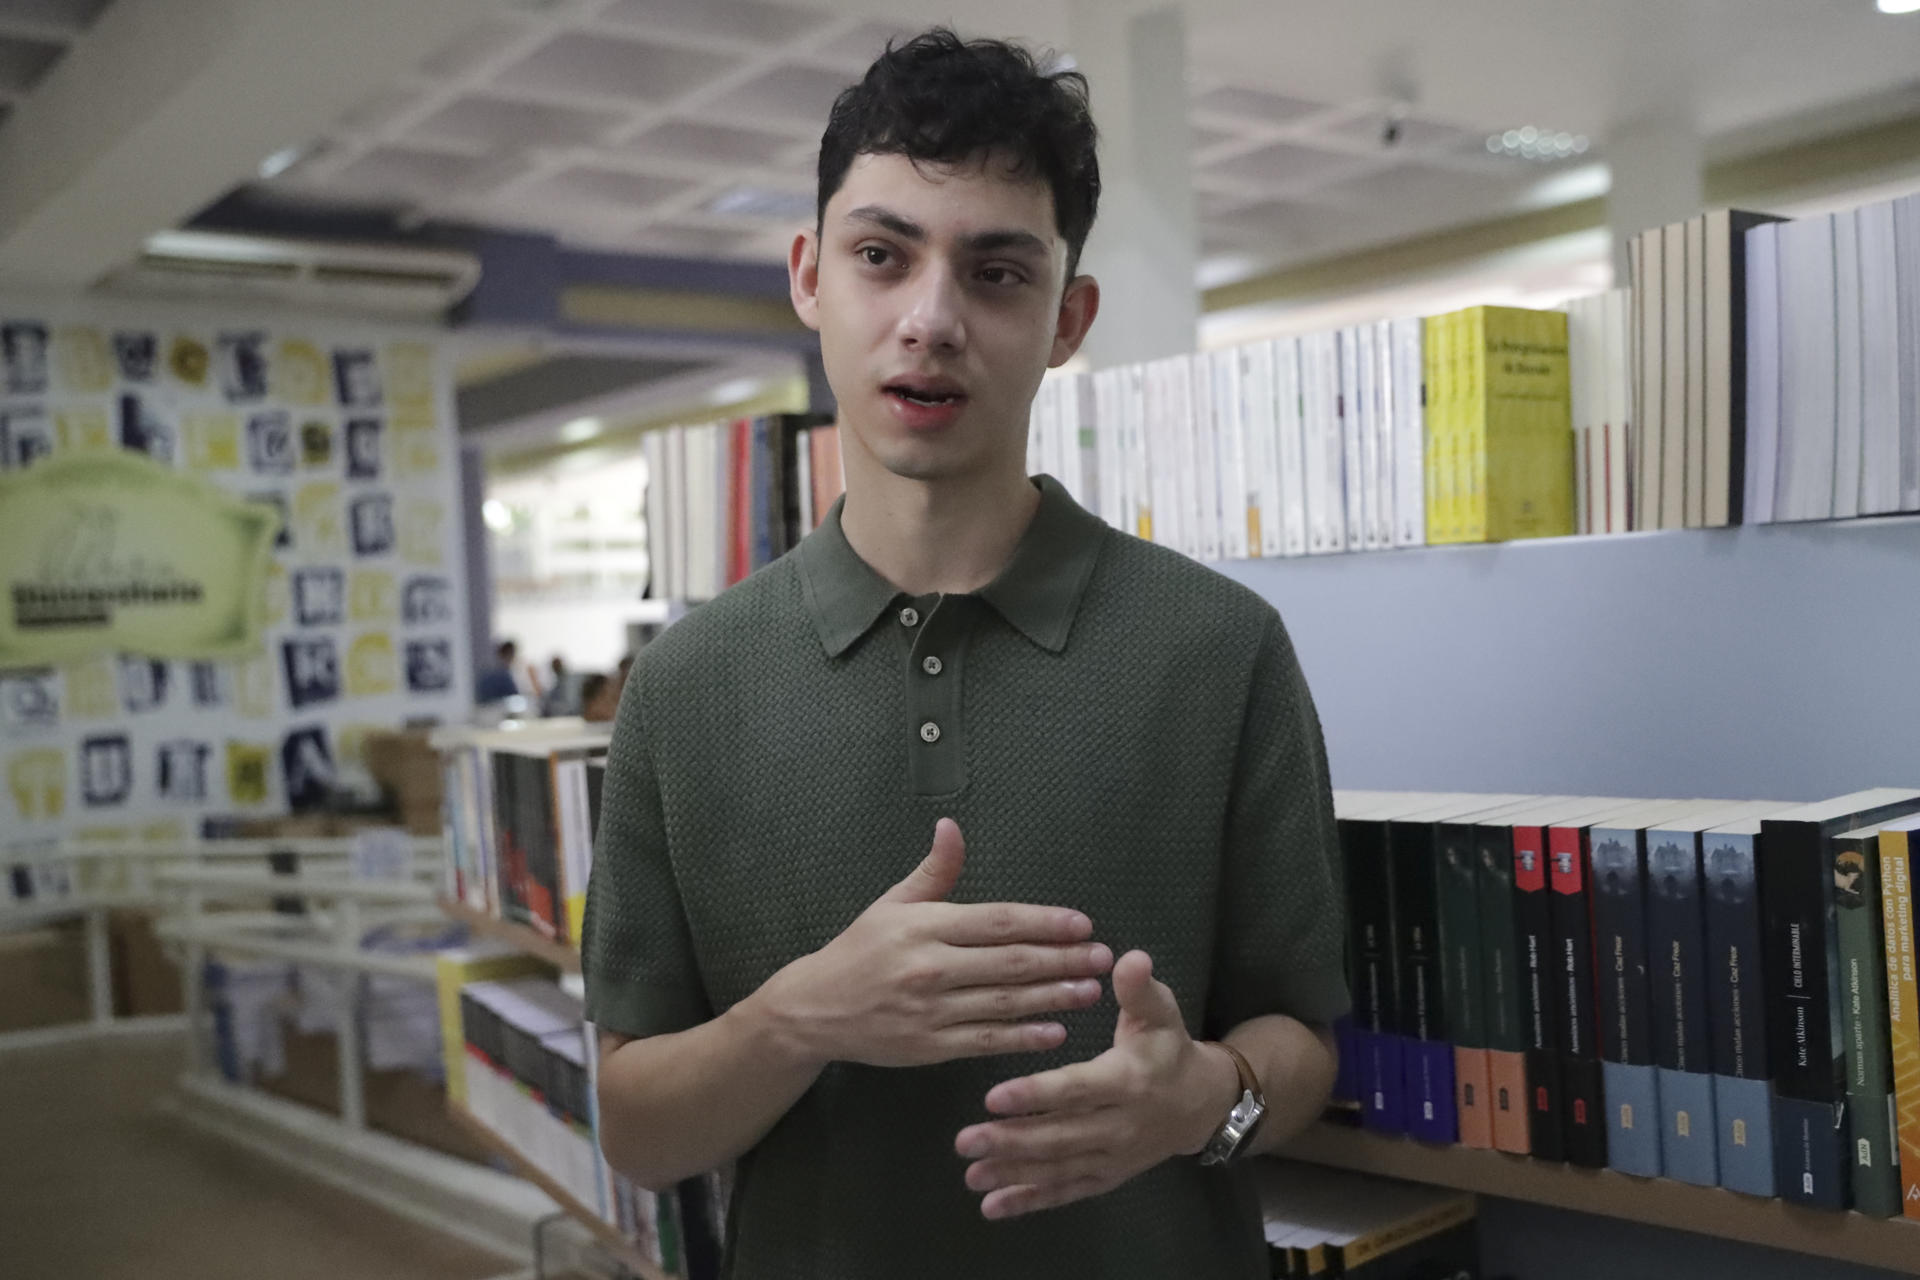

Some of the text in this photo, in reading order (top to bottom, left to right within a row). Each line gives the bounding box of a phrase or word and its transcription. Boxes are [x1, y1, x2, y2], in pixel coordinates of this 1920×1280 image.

[1882, 857, 1893, 895] Python
[1885, 899, 1894, 918] con
[1894, 857, 1912, 981] para marketing digital
[1528, 935, 1536, 951] Hart
[1565, 938, 1574, 955] Hart
[1614, 936, 1622, 956] Frear
[1887, 923, 1896, 953] datos
[1529, 952, 1537, 968] Rob
[1671, 941, 1679, 961] Frear
[1729, 946, 1737, 966] Frear
[1792, 923, 1803, 987] CIELO INTERMINABLE
[1566, 956, 1574, 971] Rob
[1888, 957, 1897, 970] de
[1730, 968, 1738, 983] Caz
[1732, 989, 1740, 1026] acciones
[1850, 959, 1865, 1086] Normas aparte Kate Atkinson
[1796, 1007, 1808, 1066] Kate Atkinson
